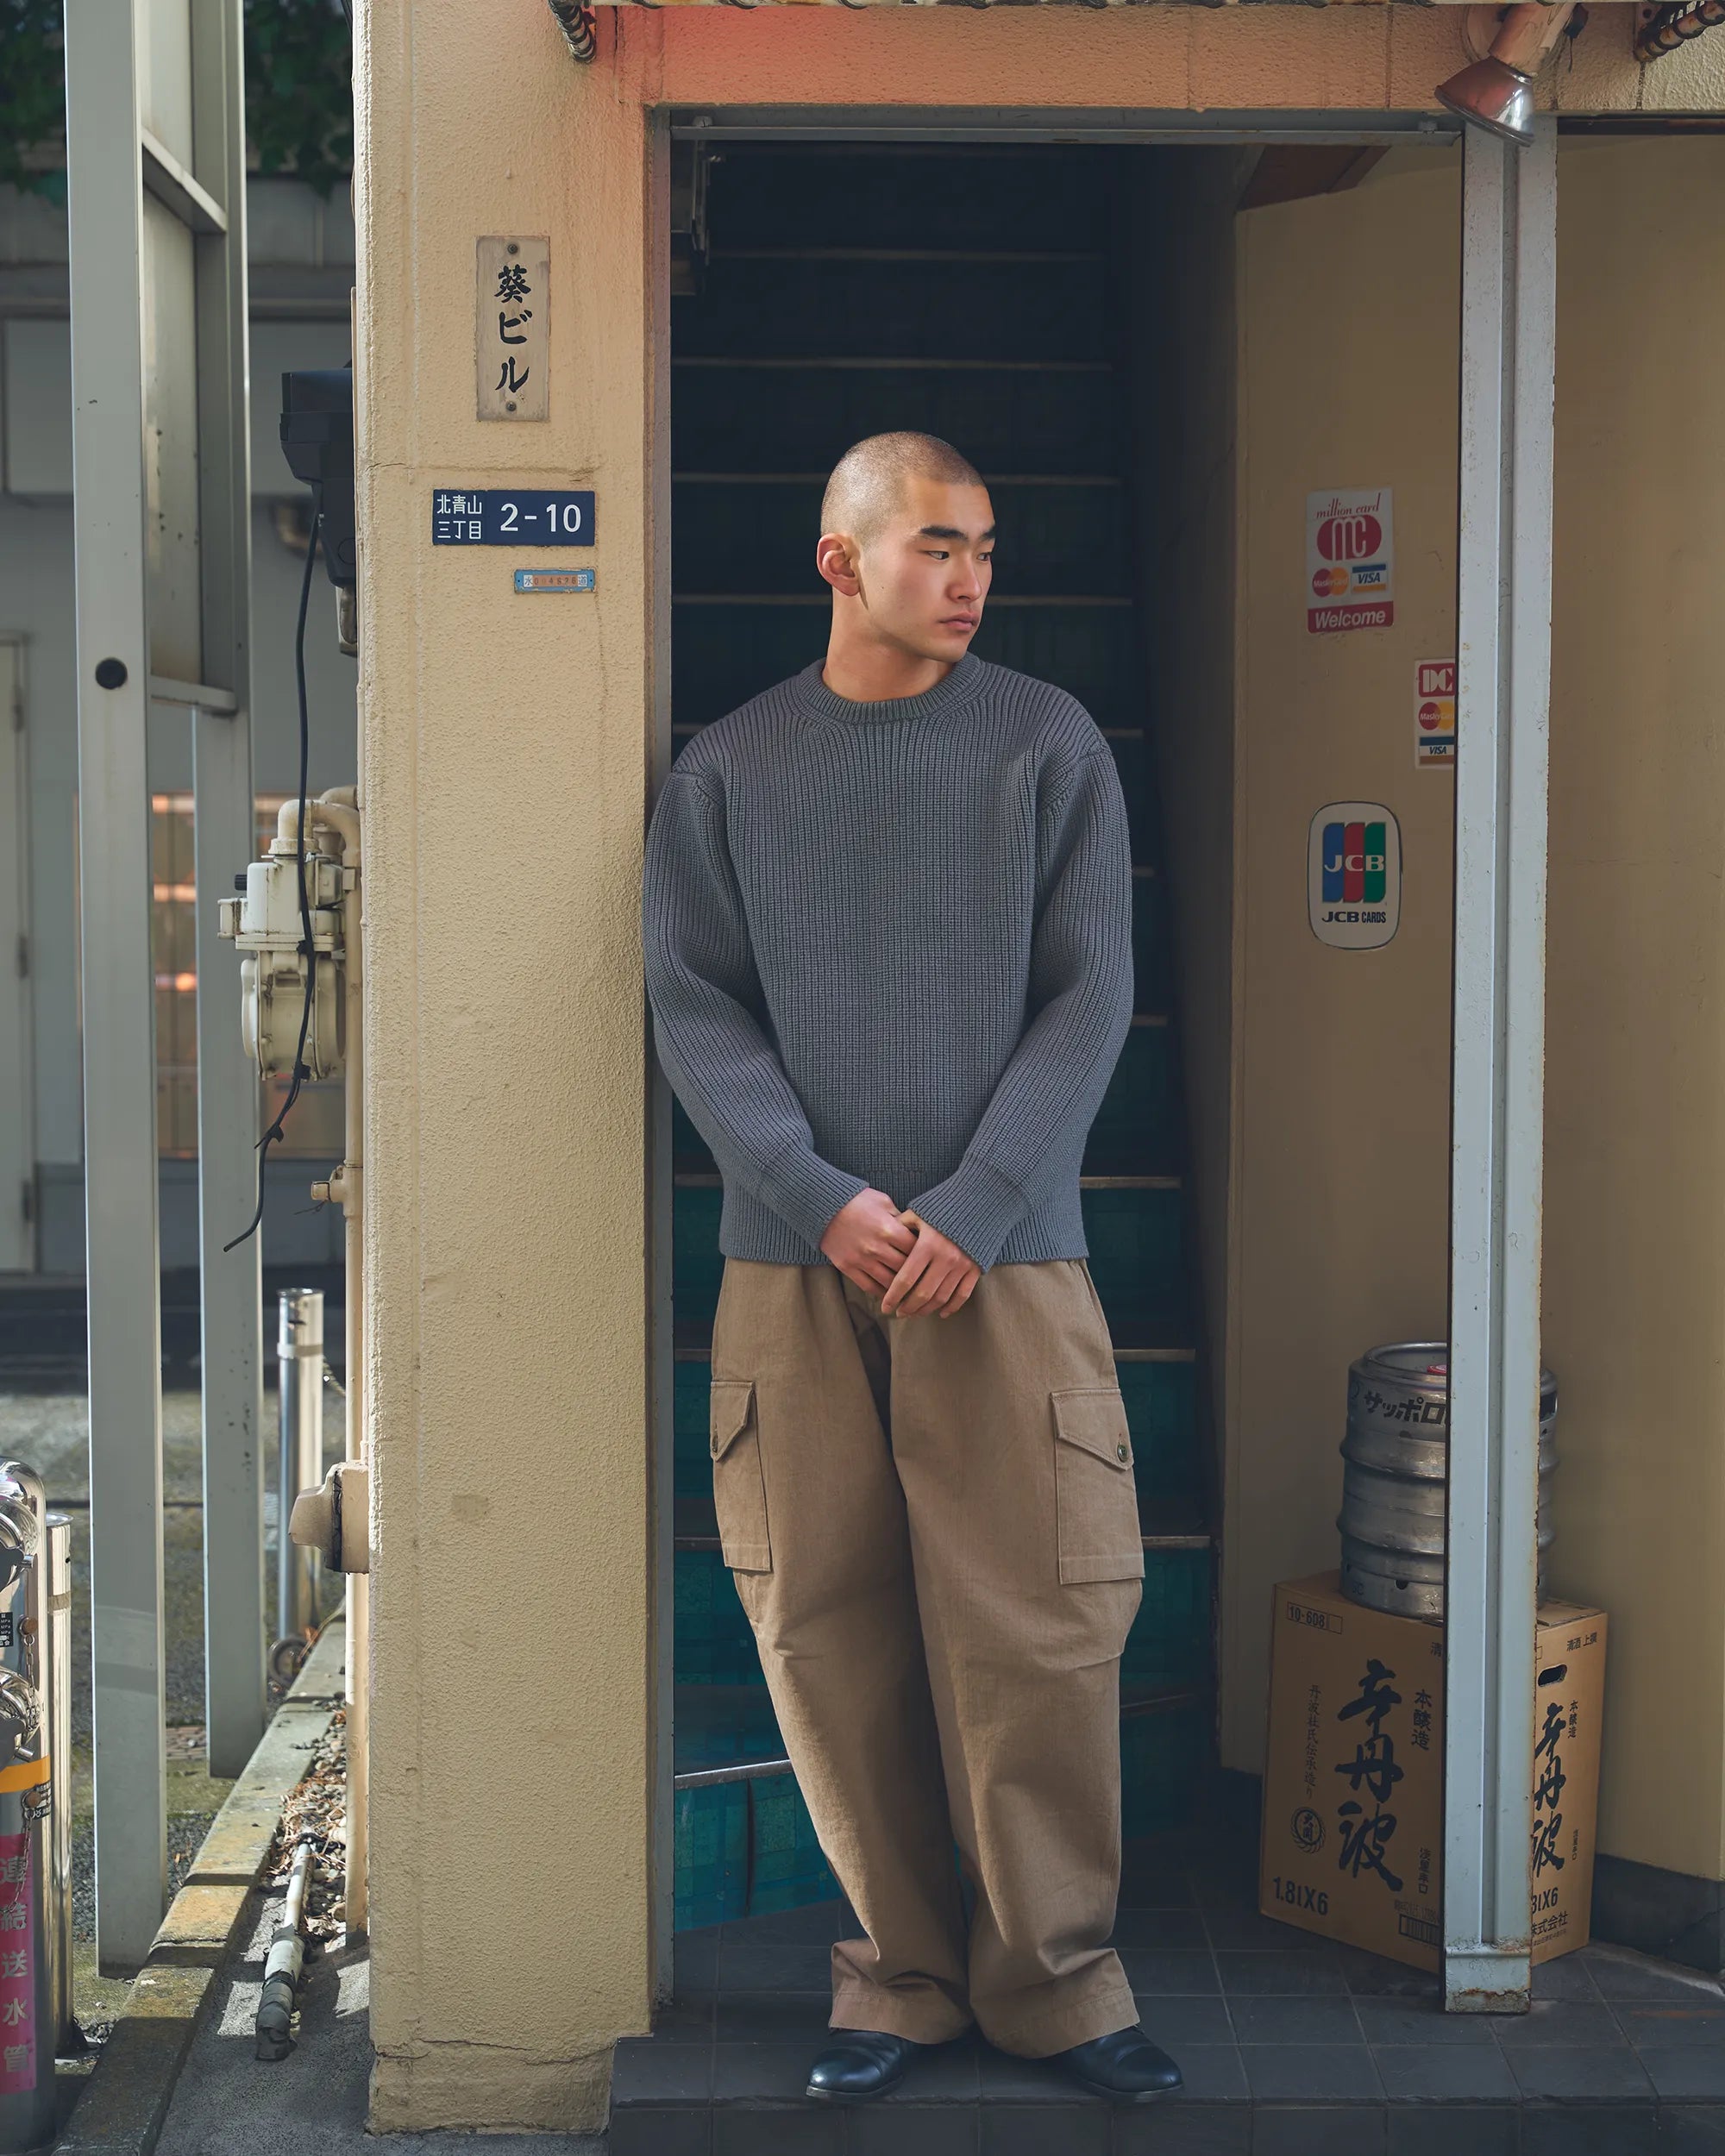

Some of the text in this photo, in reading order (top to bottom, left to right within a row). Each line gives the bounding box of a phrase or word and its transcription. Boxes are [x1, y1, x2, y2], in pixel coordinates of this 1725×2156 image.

[494, 264, 532, 393] 葵ビル
[436, 494, 482, 515] 北青山
[1315, 492, 1380, 519] million card
[500, 503, 581, 533] 2-10
[437, 520, 481, 540] 三丁目
[1357, 572, 1381, 585] VISA
[1314, 609, 1386, 630] Welcome
[1422, 667, 1452, 693] DC
[1429, 745, 1447, 755] VISA
[1324, 855, 1384, 873] JCB
[1321, 912, 1386, 924] JCB CARDS
[1364, 1390, 1446, 1425] サッポロ
[1410, 1688, 1432, 1751] 本醸造
[1334, 1658, 1404, 1892] 辛丹波
